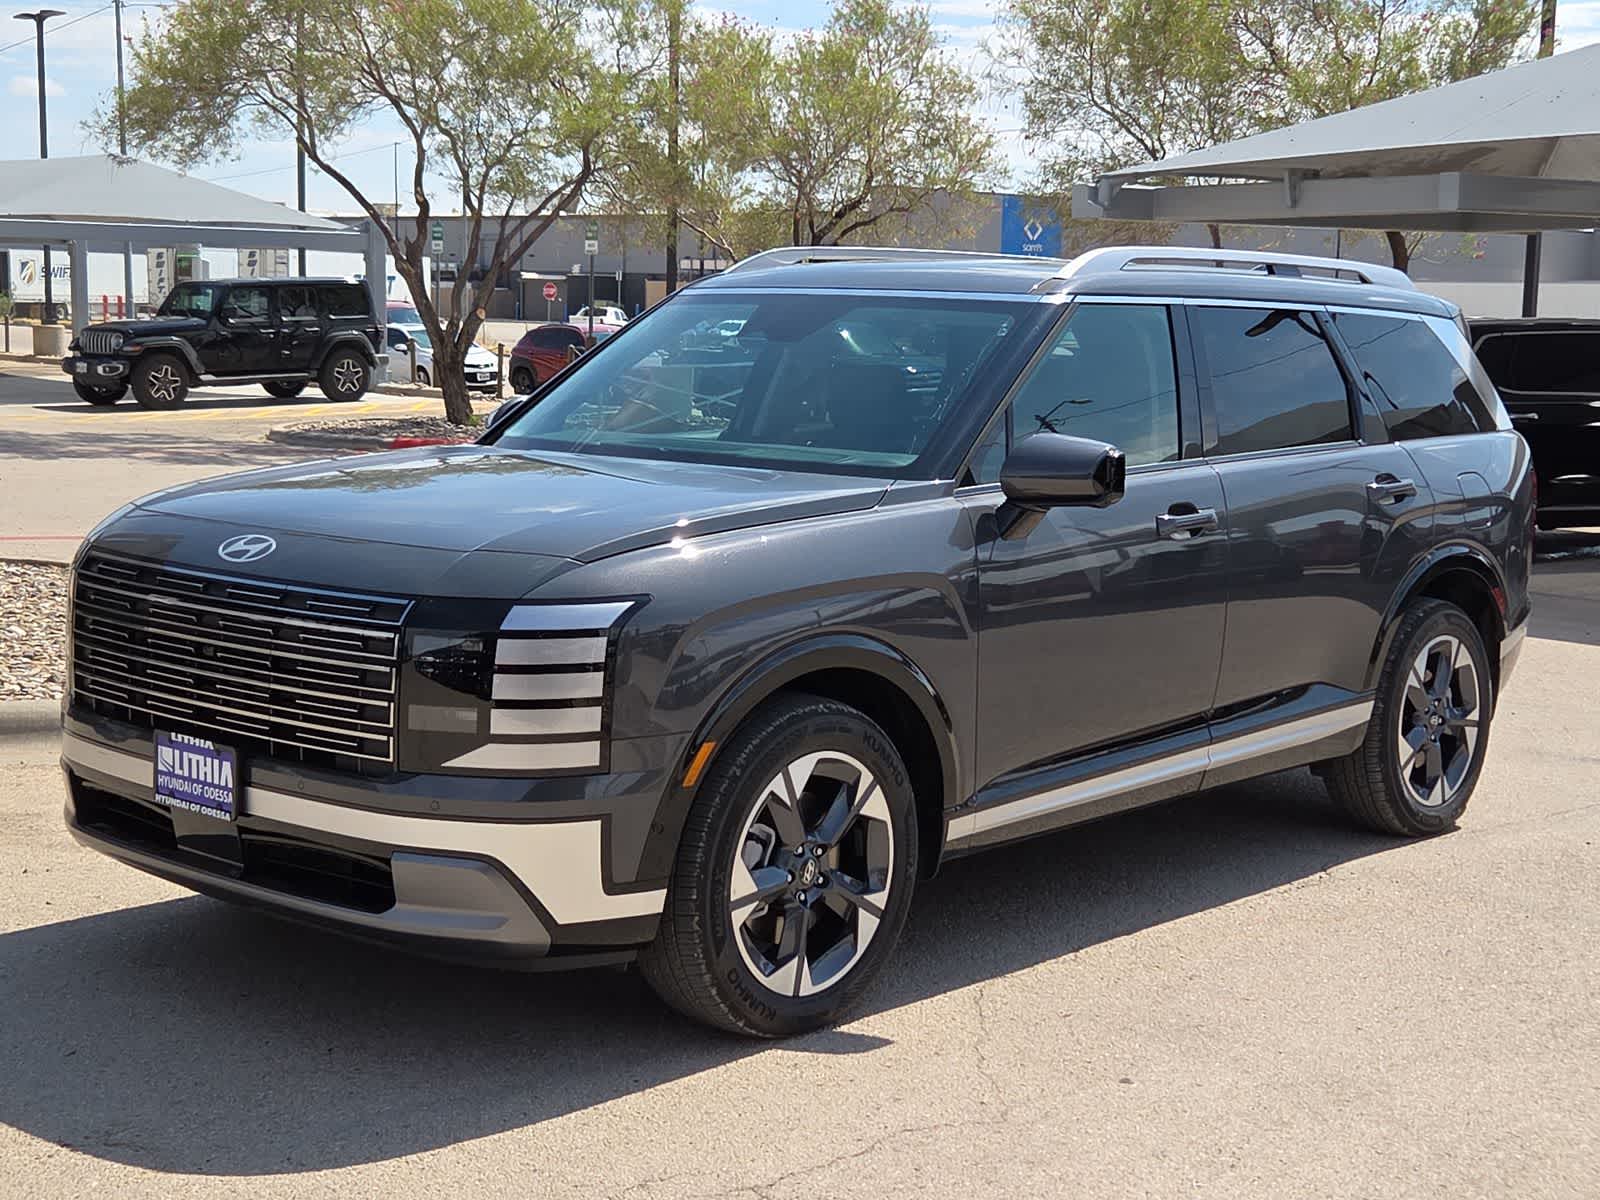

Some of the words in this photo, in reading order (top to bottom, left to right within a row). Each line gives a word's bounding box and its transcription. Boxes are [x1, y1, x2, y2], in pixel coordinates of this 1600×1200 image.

[171, 732, 214, 750] LITHIA
[174, 749, 232, 787] LITHIA
[158, 774, 191, 792] HYUNDAI
[192, 784, 203, 796] OF
[204, 786, 232, 803] ODESSA
[155, 793, 189, 809] HYUNDAI
[190, 804, 200, 814] OF
[201, 806, 230, 822] ODESSA
